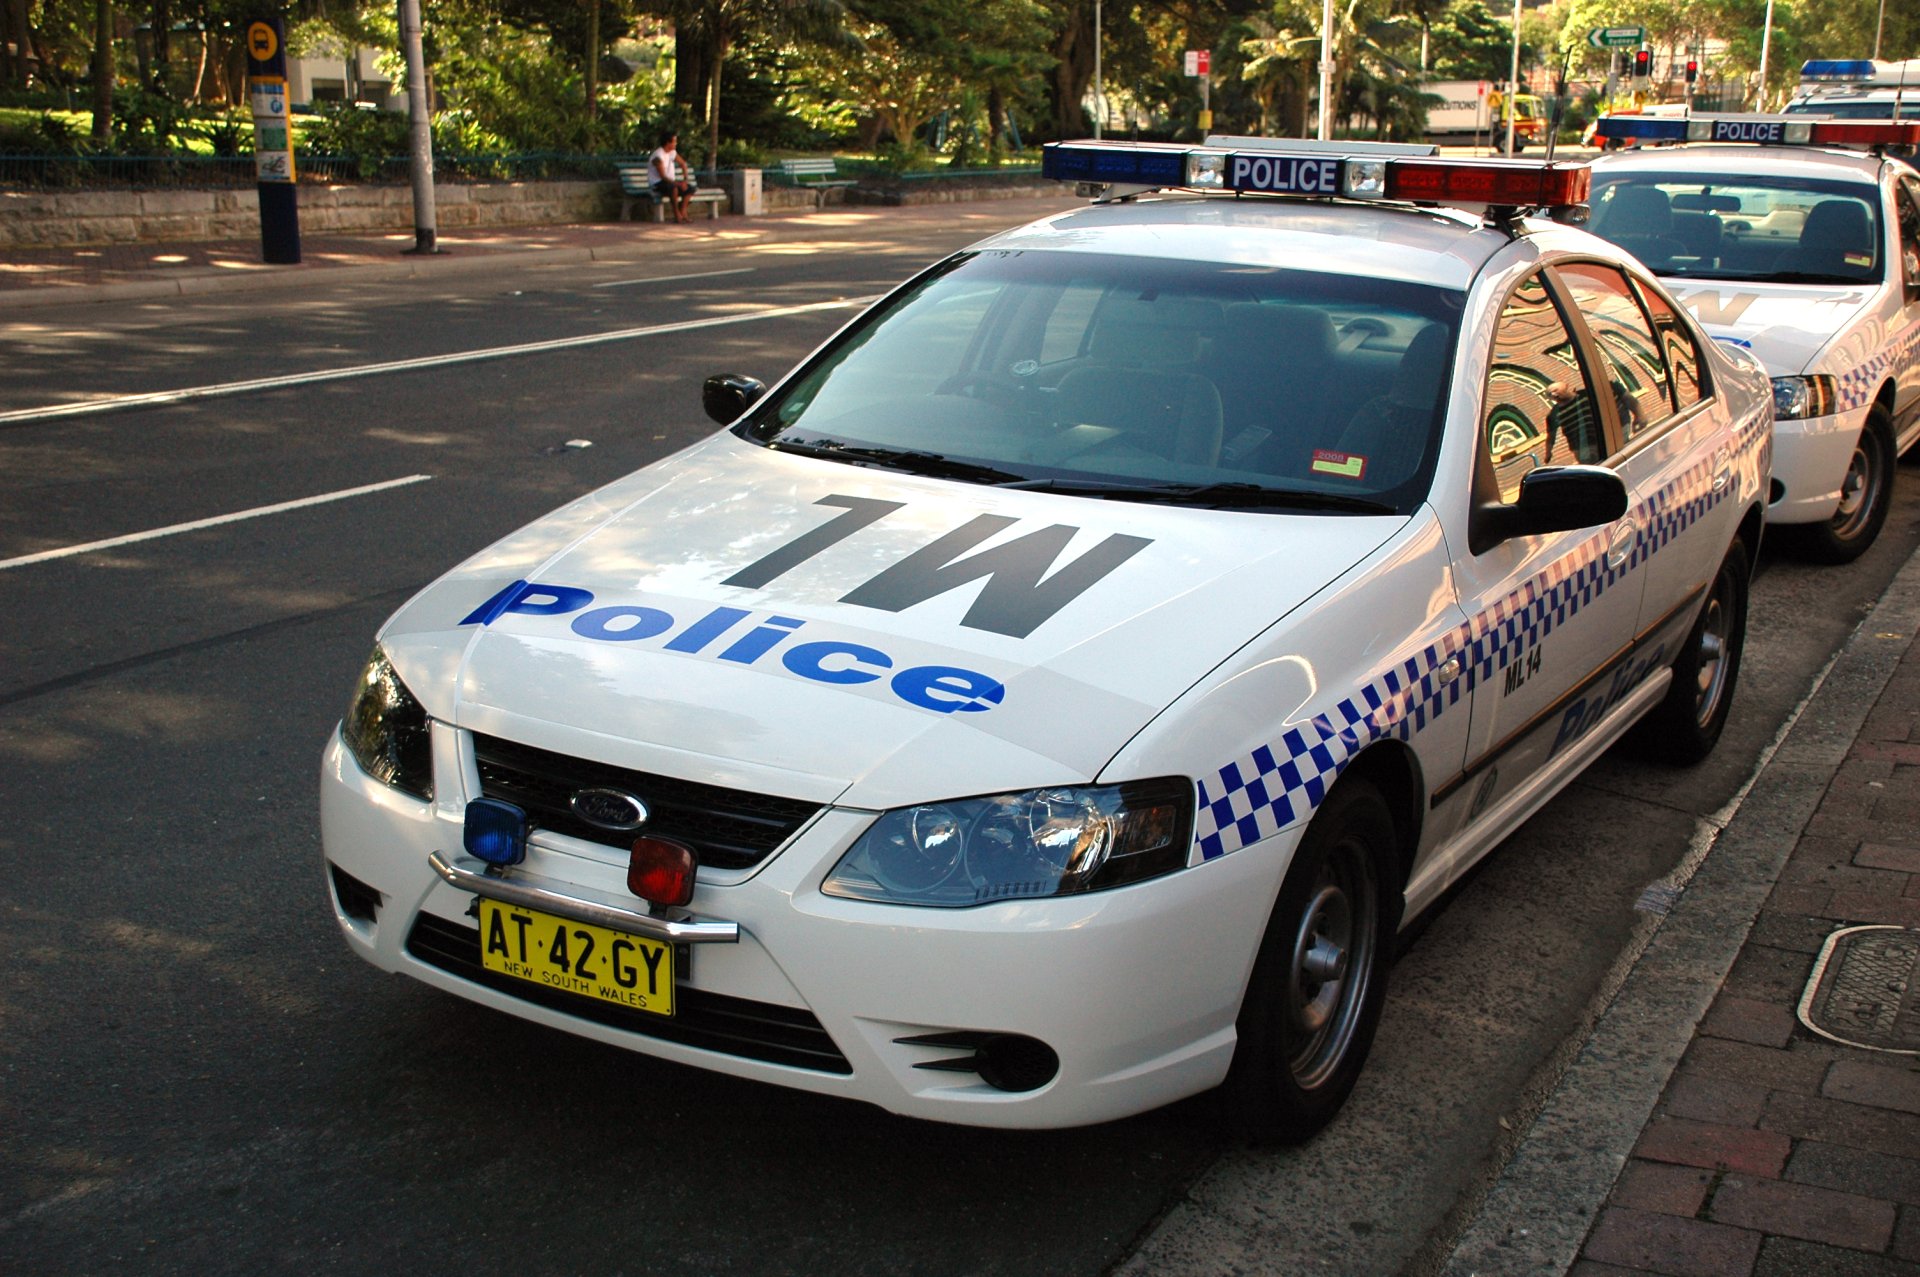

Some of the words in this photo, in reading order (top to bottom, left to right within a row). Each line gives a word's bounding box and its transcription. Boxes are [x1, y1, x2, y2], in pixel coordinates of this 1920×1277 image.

[1716, 123, 1780, 140] POLICE
[1233, 158, 1337, 192] POLICE
[459, 579, 1006, 715] Police
[504, 961, 534, 978] NEW
[542, 971, 590, 993] SOUTH
[598, 985, 648, 1008] WALES
